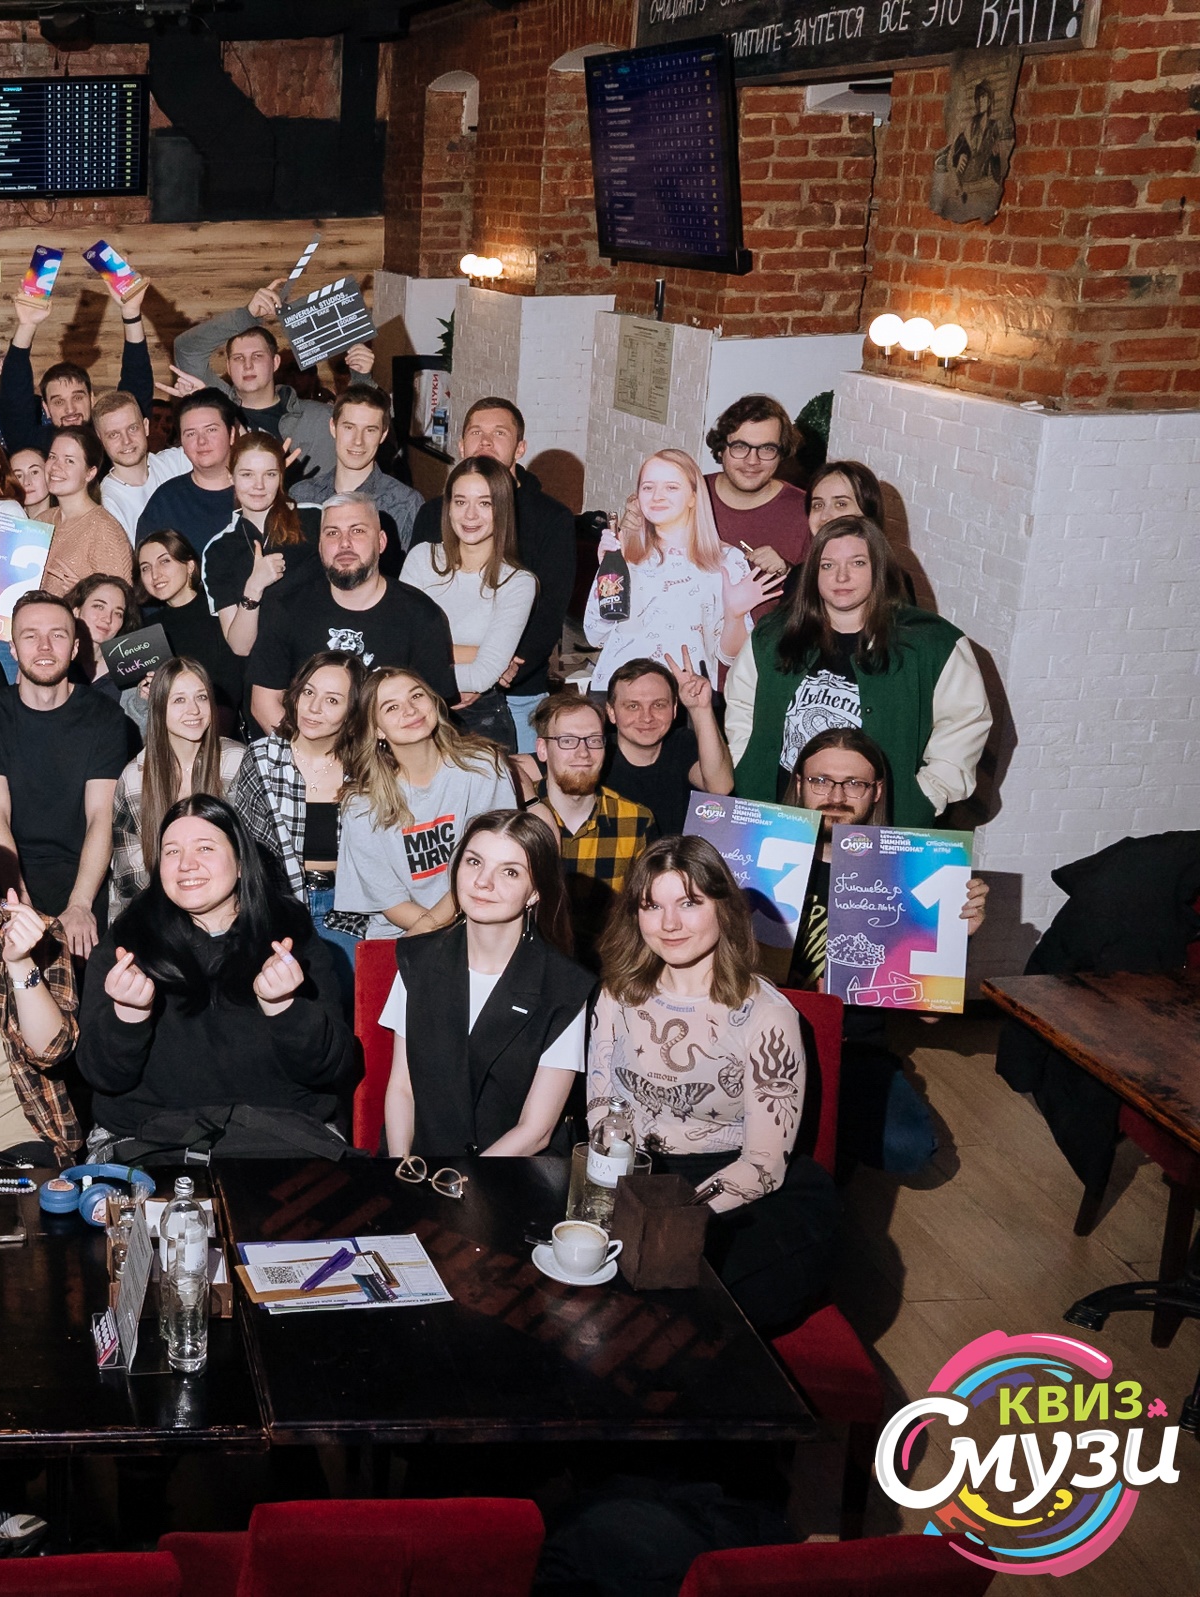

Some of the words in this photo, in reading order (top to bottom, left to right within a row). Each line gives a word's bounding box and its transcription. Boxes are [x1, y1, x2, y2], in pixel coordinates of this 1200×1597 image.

[284, 305, 318, 324] UNIVERSAL
[109, 638, 150, 658] Только
[696, 805, 726, 818] Смузи
[733, 809, 761, 818] ЗИМНИЙ
[732, 815, 773, 826] ЧЕМПИОНАТ
[403, 823, 455, 854] MNC
[840, 838, 873, 850] Смузи
[407, 842, 455, 873] HRN
[910, 865, 972, 978] 1
[647, 1072, 678, 1082] amour
